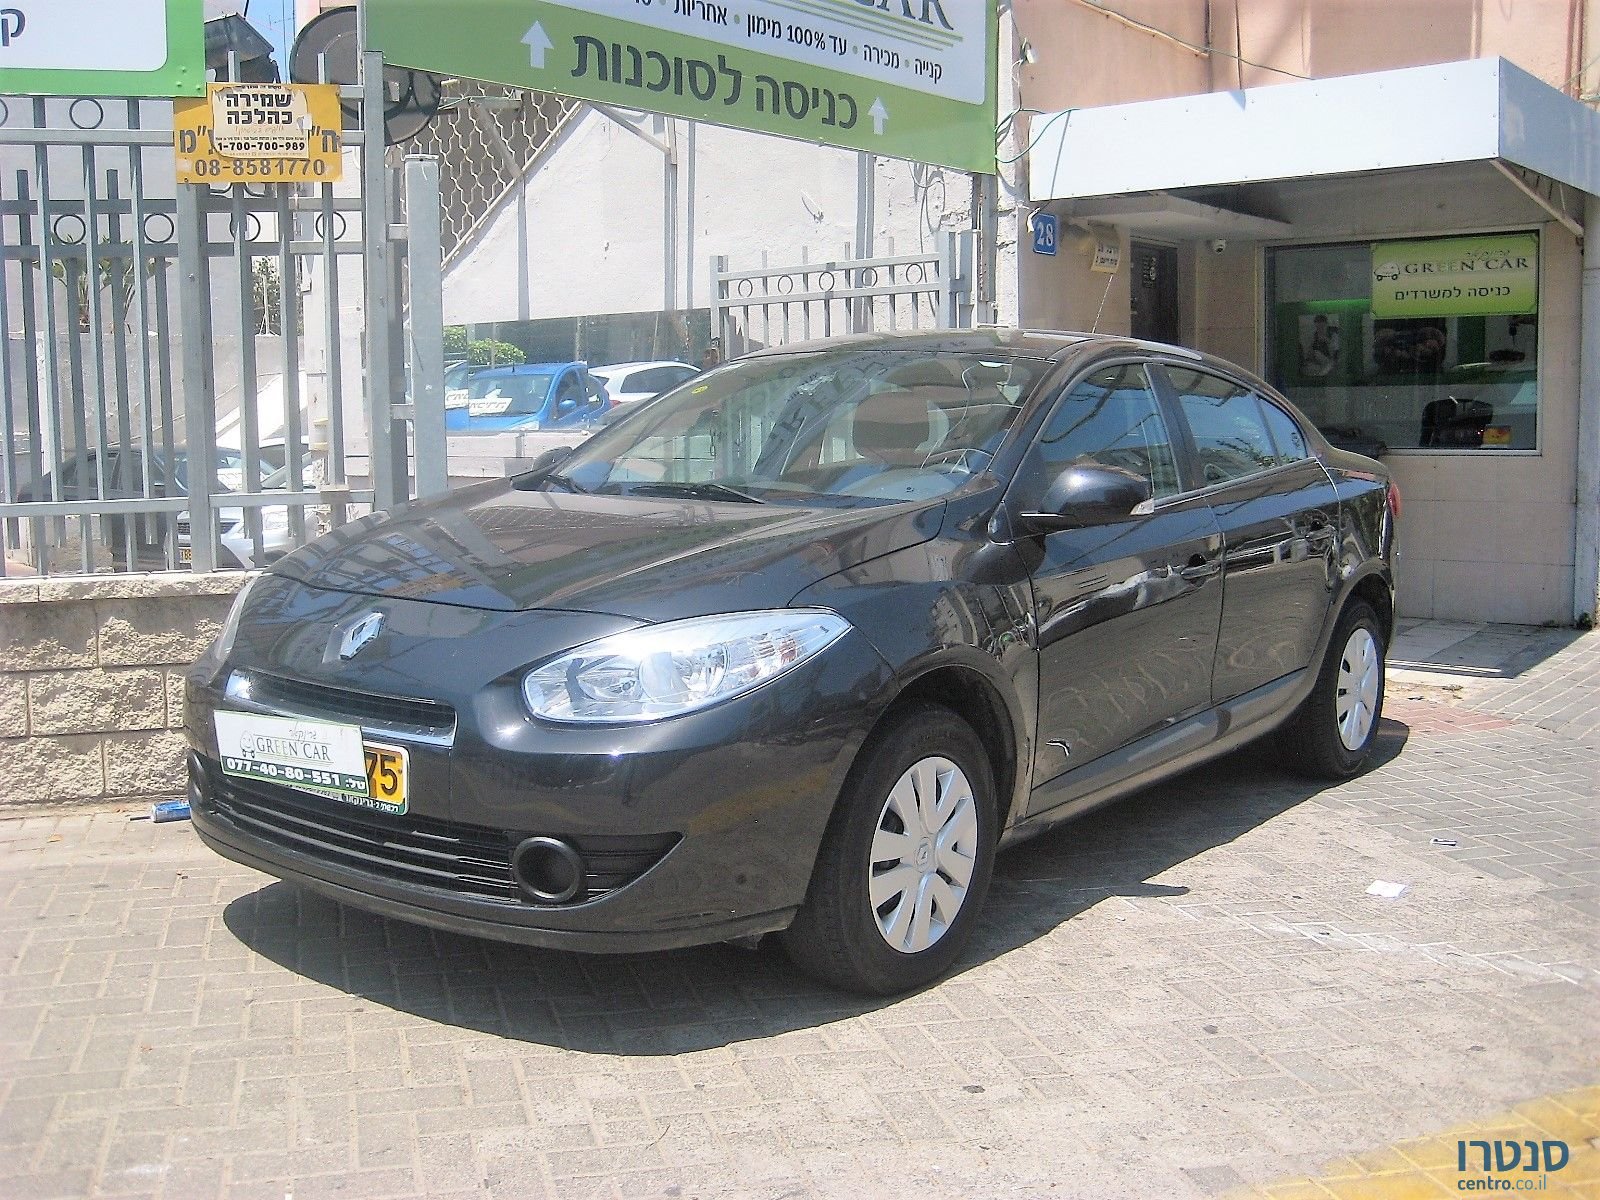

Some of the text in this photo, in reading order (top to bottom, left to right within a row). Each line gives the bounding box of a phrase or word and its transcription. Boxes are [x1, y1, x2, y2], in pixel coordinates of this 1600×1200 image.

[673, 0, 943, 85] קנייה מכירה עד 100% מימון אחריות
[570, 35, 859, 130] כניסה לסוכנות
[226, 93, 292, 107] שמירה
[226, 108, 294, 125] כהלכה
[217, 141, 305, 151] 1-700-700-989
[194, 158, 326, 177] 08-8581770
[1036, 221, 1055, 247] 28
[1404, 257, 1529, 274] GREEN CAR
[1394, 285, 1511, 301] כניסה למשרדים
[256, 736, 331, 762] GREEN CAR
[226, 757, 341, 787] 077-40-80-551
